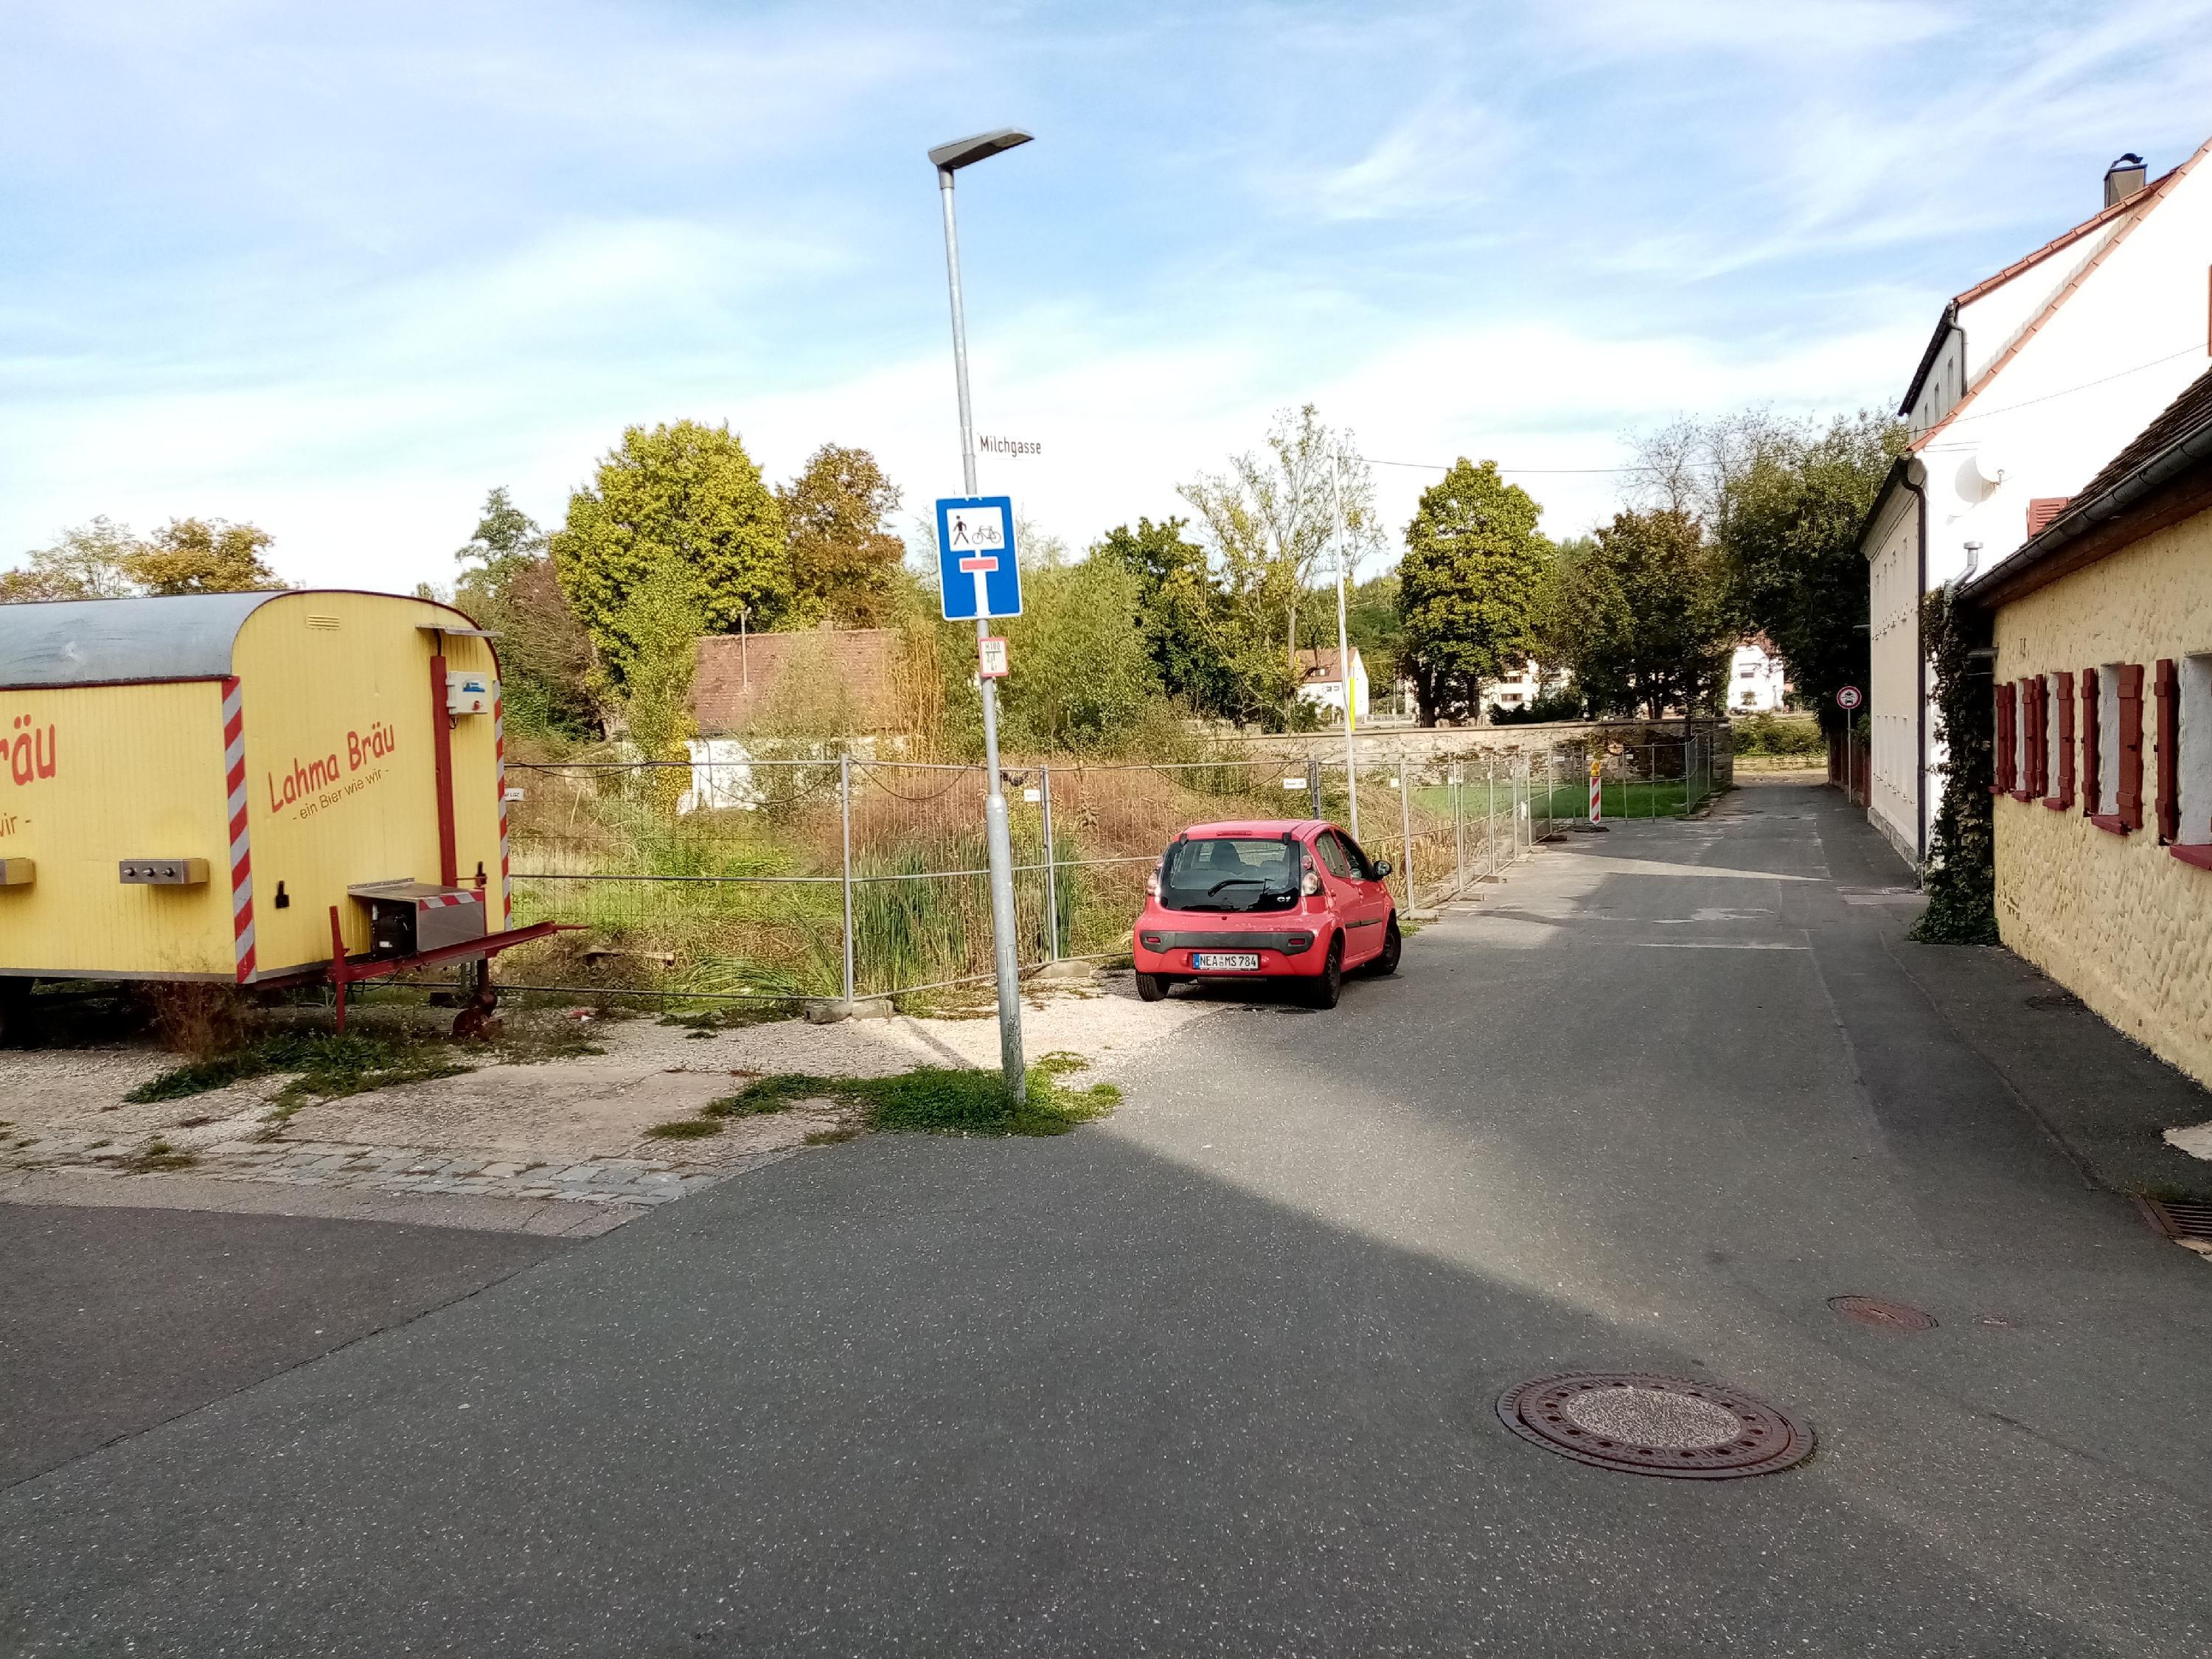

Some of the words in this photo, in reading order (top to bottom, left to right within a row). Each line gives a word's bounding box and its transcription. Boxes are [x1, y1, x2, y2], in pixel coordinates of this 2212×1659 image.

[980, 435, 1040, 458] Milchgasse
[268, 754, 340, 813] Lahma
[347, 721, 394, 771] Bräu
[299, 803, 318, 819] ein
[319, 790, 341, 808] Bier
[344, 779, 364, 796] wie
[365, 768, 382, 785] wir
[1200, 956, 1218, 967] NEA
[1225, 956, 1237, 967] MS
[1239, 956, 1256, 967] 784
